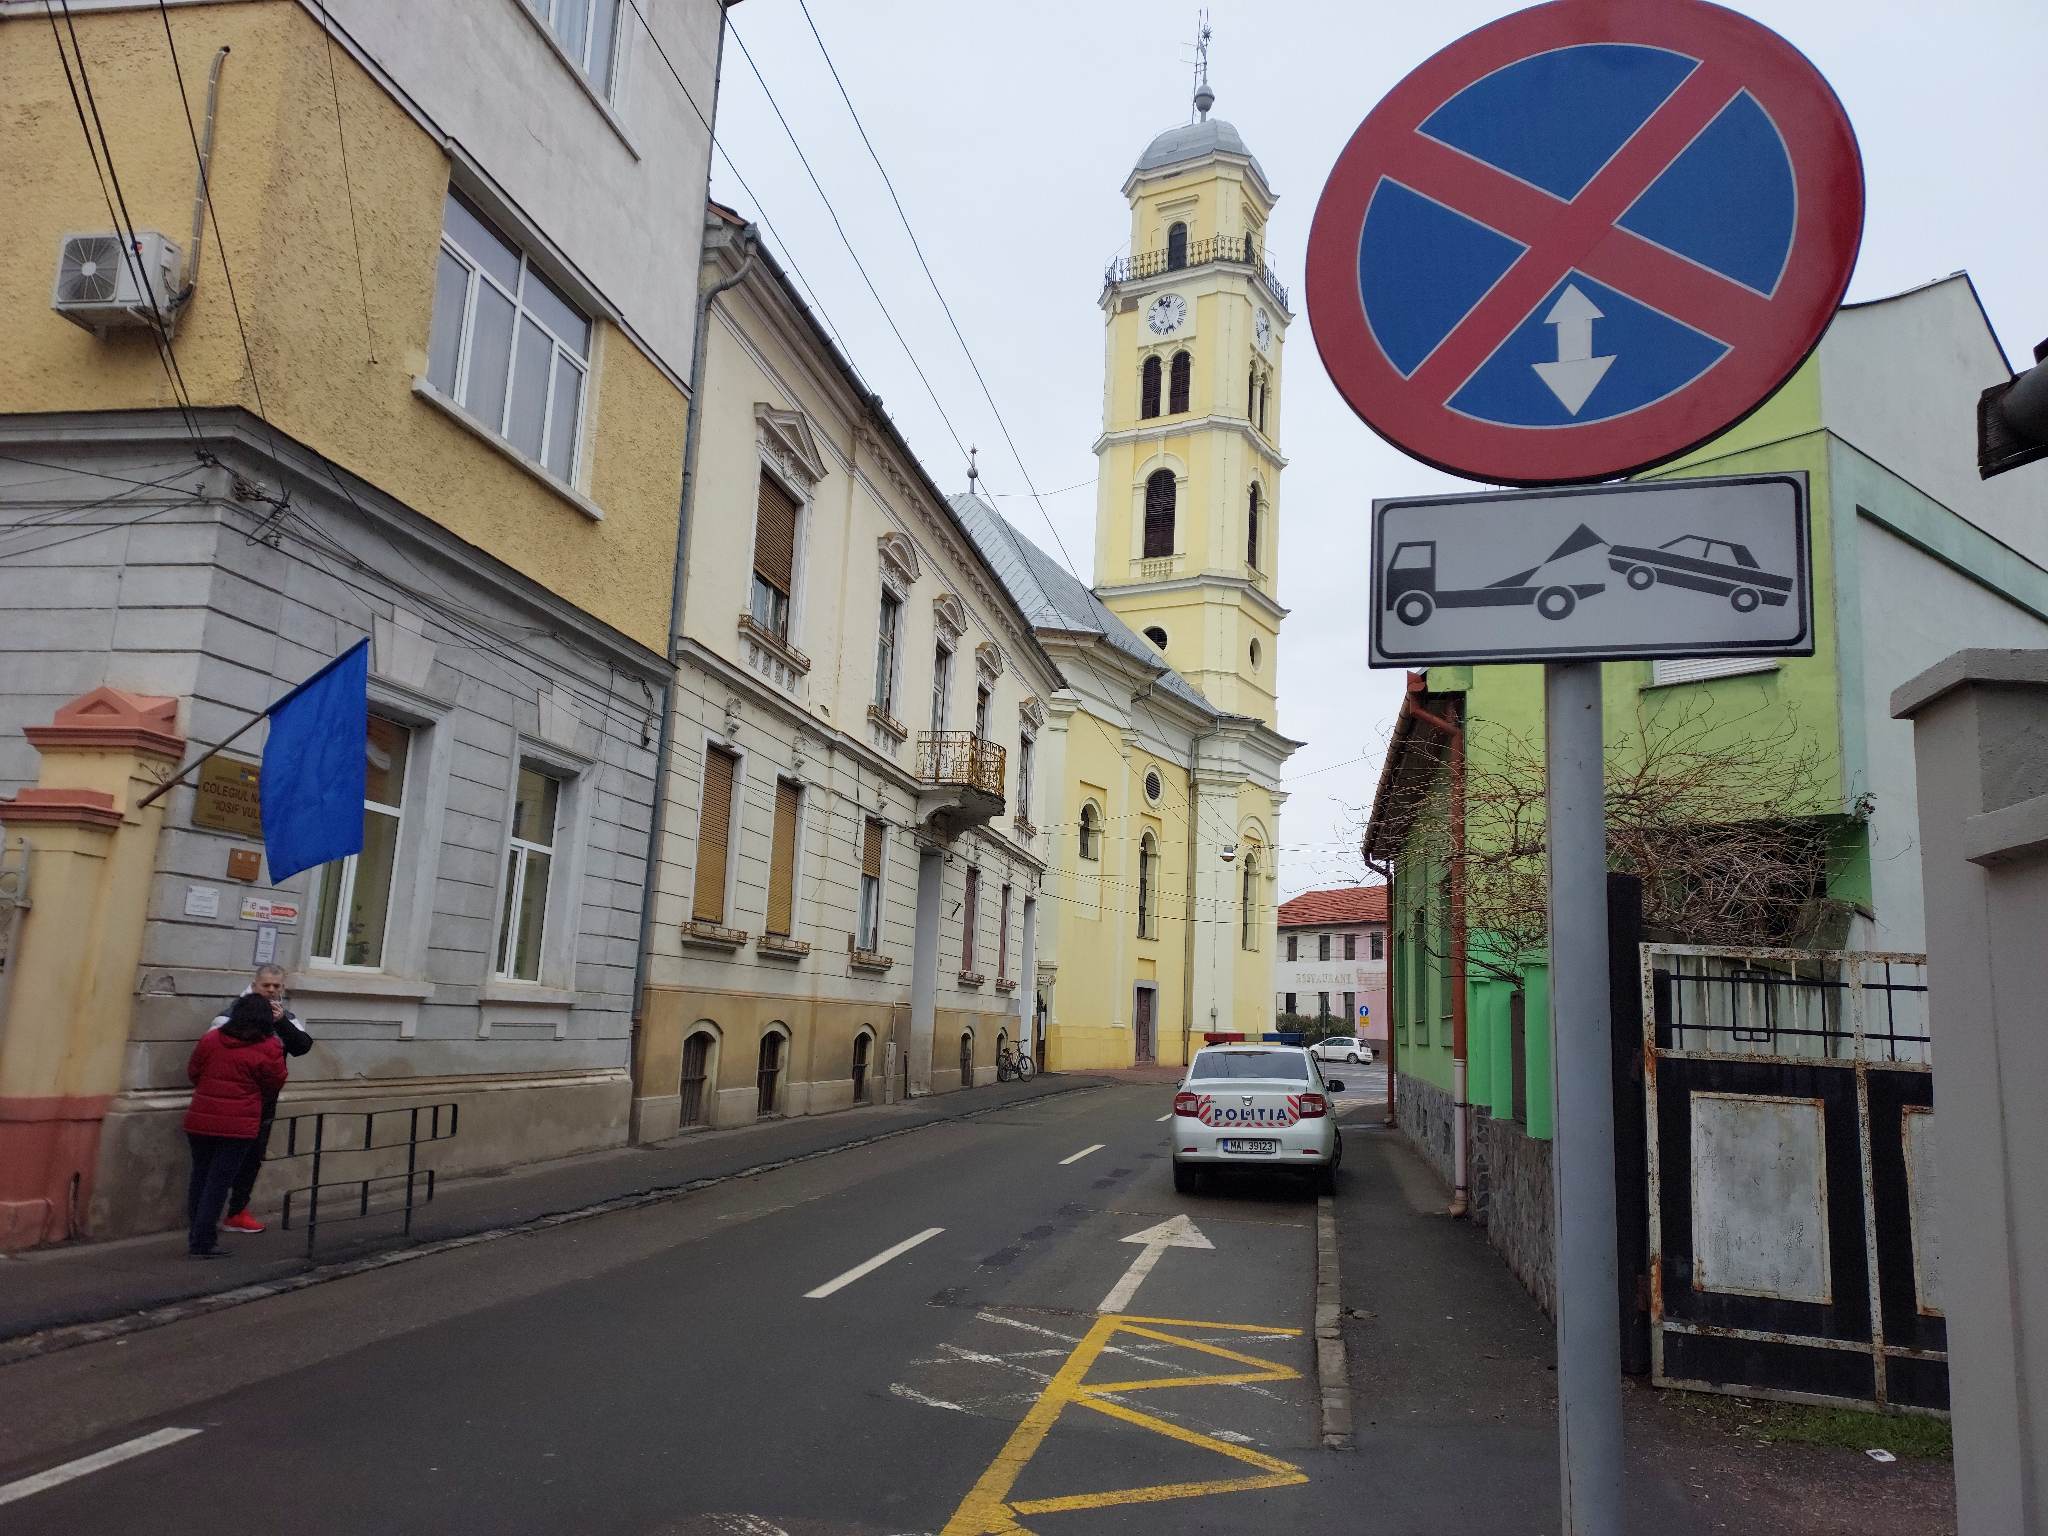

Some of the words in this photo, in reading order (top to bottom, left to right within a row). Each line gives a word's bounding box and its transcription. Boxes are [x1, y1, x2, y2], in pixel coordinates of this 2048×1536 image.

[202, 781, 249, 801] COLEGIUL
[1230, 1140, 1244, 1151] MAI
[1248, 1141, 1273, 1151] 39123
